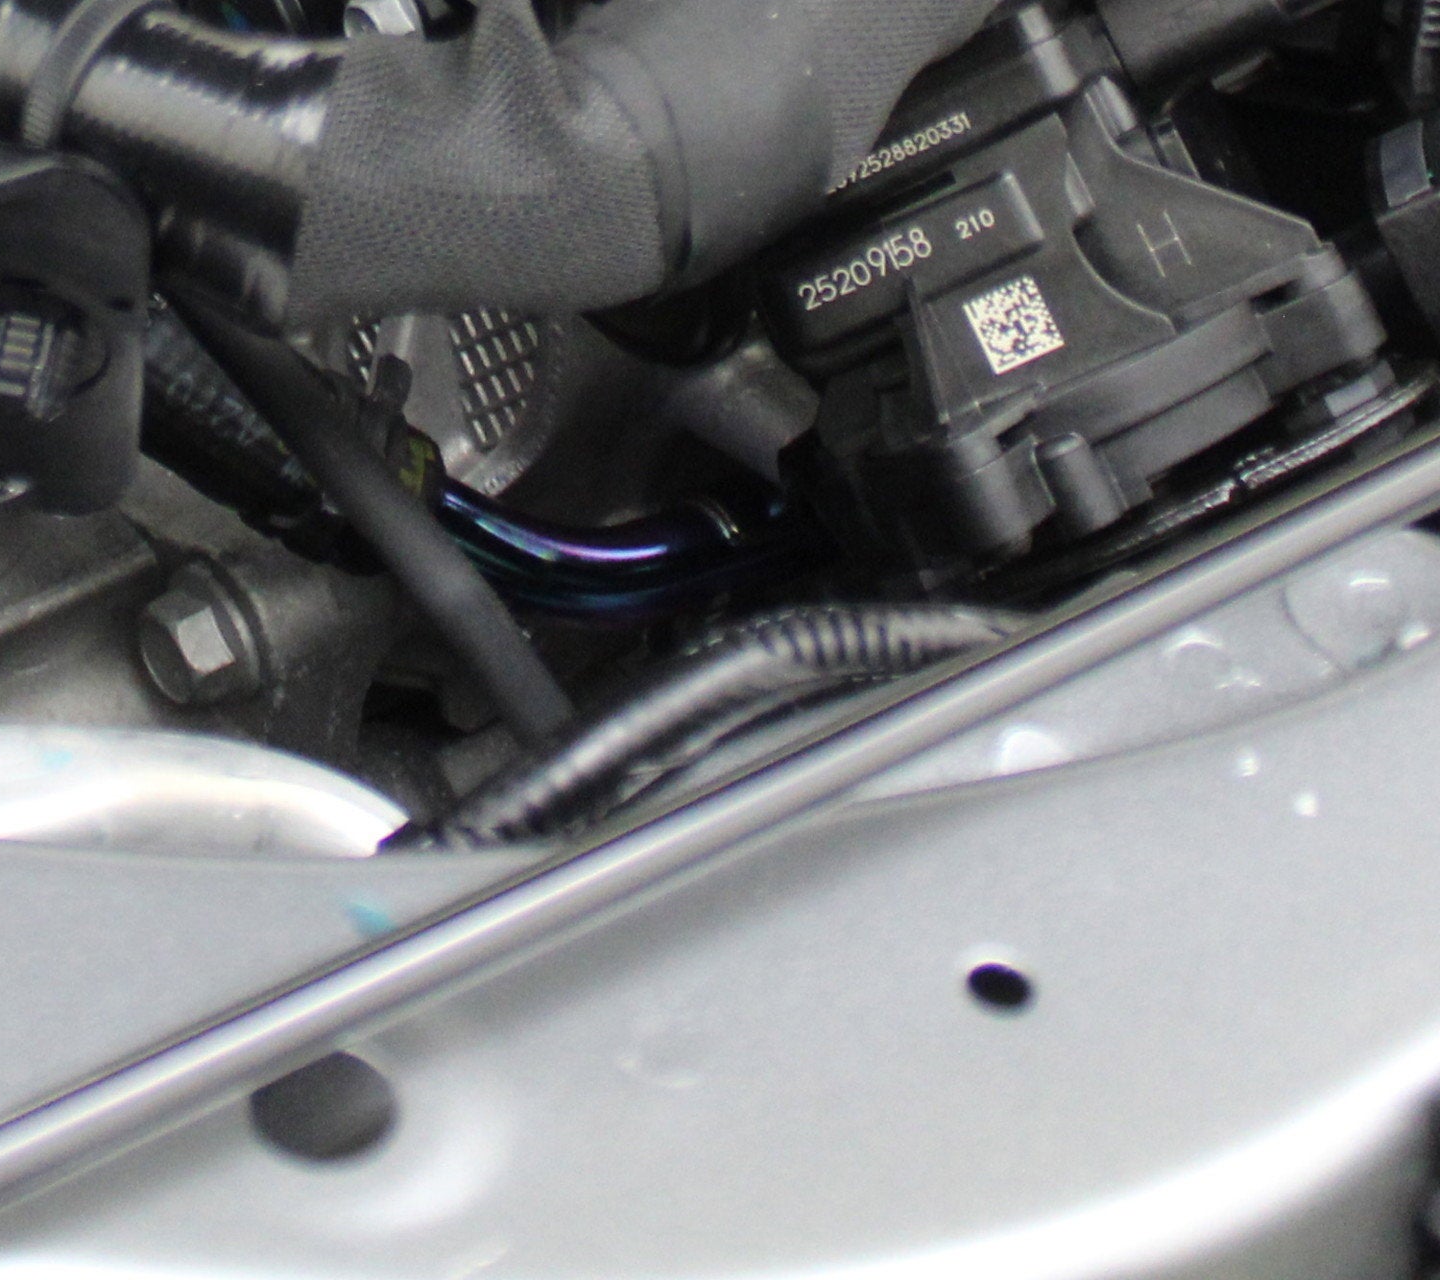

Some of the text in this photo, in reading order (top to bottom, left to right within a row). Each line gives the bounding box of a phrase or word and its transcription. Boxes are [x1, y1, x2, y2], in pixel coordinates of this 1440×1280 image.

[826, 112, 971, 194] 2528820331
[797, 209, 995, 311] 25209158 210
